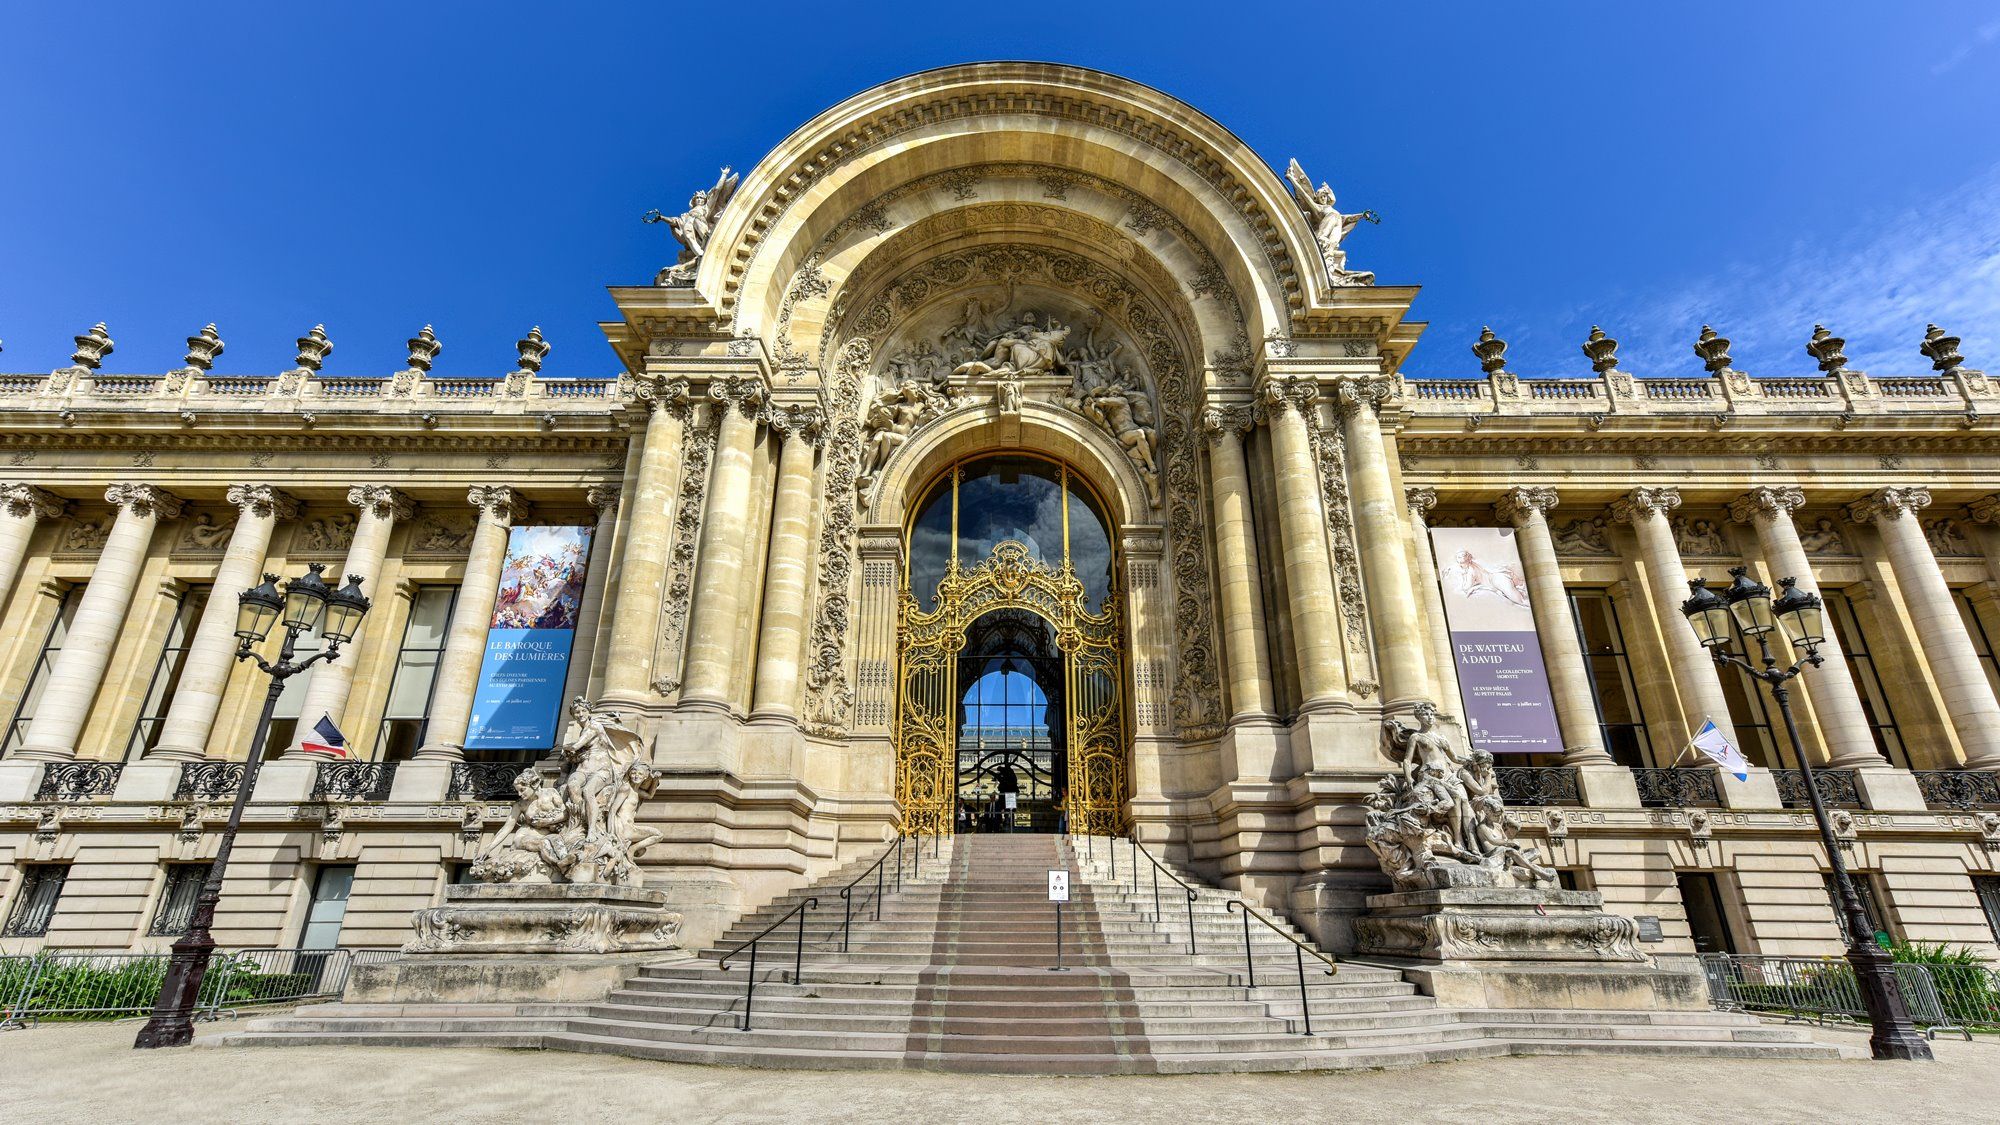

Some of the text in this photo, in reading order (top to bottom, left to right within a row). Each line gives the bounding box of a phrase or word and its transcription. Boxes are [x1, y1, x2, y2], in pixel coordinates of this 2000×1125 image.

[490, 641, 553, 652] LE BAROQUE
[1460, 644, 1524, 652] DE WATTEAU
[494, 650, 565, 661] DES LUMIÈRES
[1462, 653, 1502, 664] À DAVID
